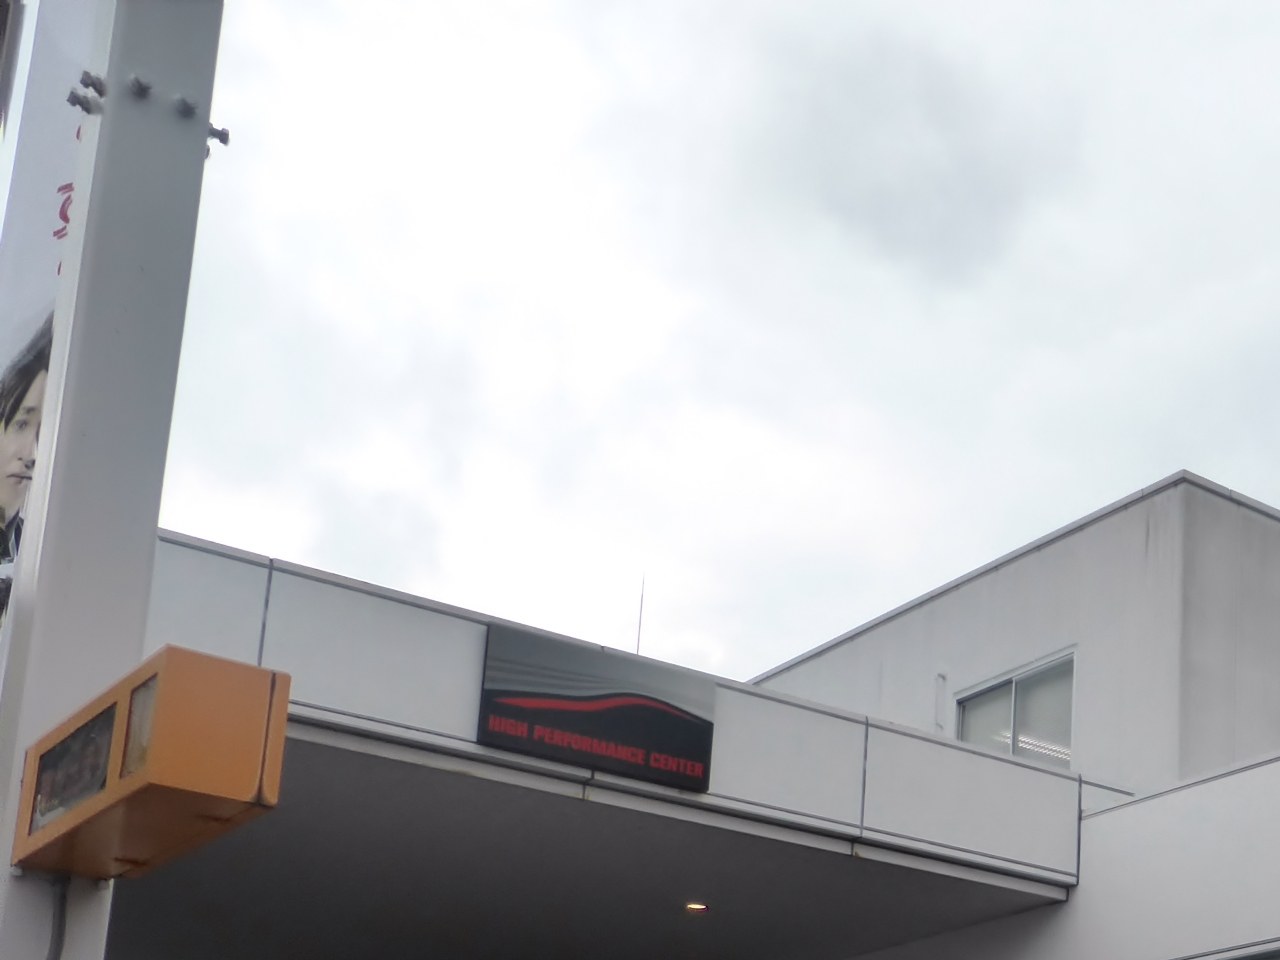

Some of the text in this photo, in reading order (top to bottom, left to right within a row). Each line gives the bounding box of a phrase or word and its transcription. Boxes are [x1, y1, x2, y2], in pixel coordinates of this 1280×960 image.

[488, 714, 703, 777] HIGH PERFORMANCE CENTER
